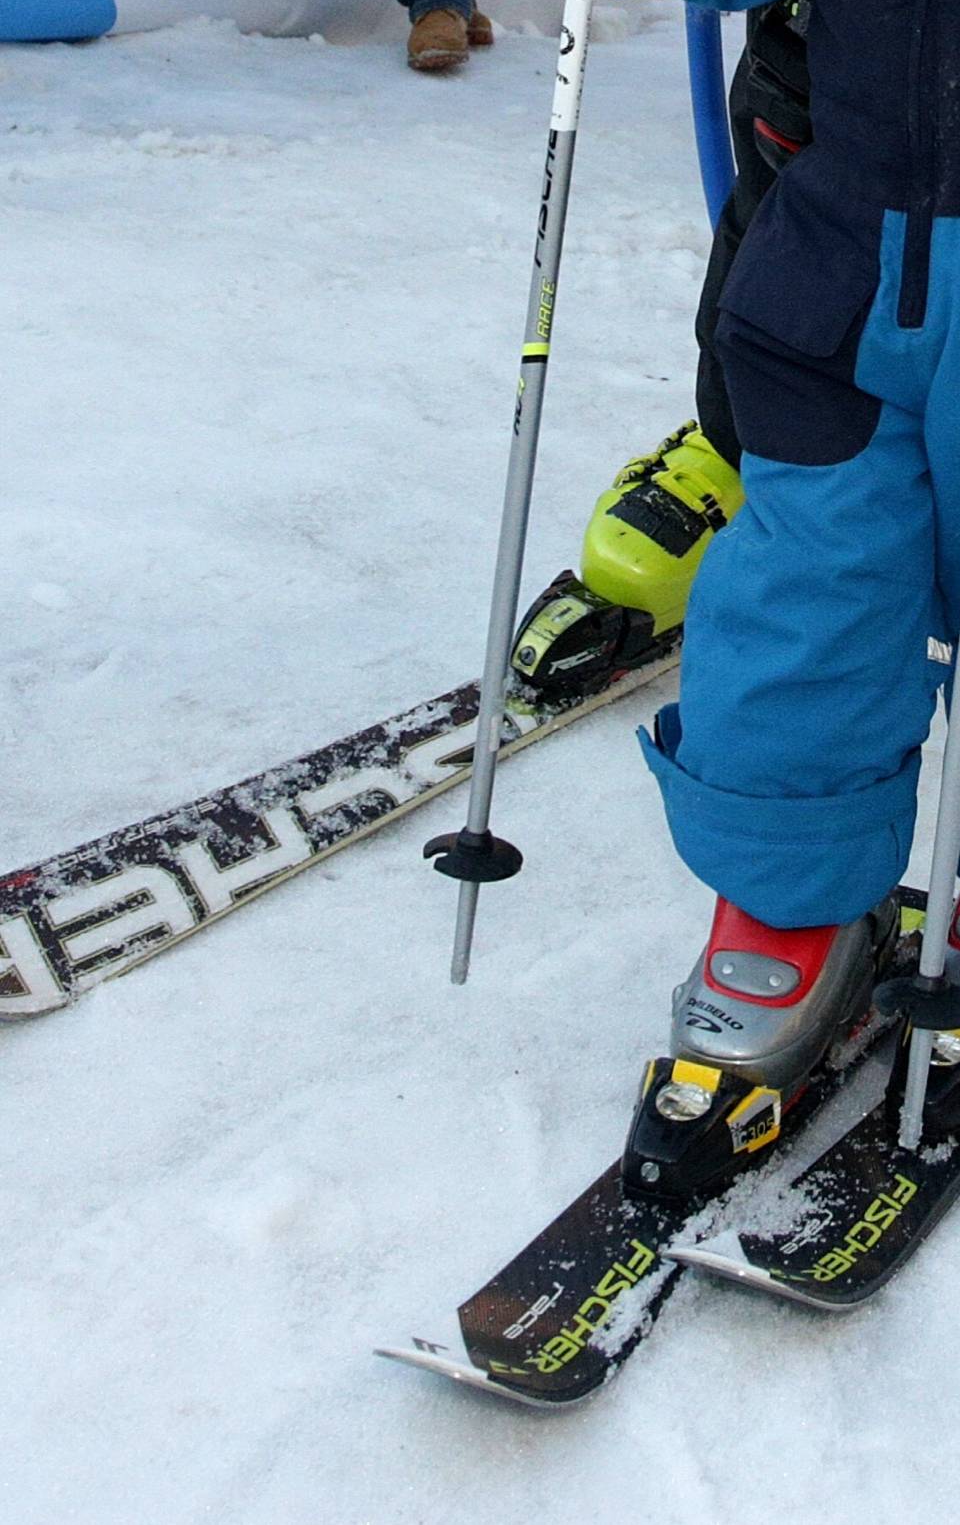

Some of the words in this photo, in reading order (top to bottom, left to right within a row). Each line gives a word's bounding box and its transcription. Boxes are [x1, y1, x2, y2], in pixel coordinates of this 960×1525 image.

[537, 279, 556, 339] RACE
[810, 1174, 917, 1286] FISCHER
[502, 1280, 565, 1341] race
[524, 1238, 657, 1375] FISCHER
